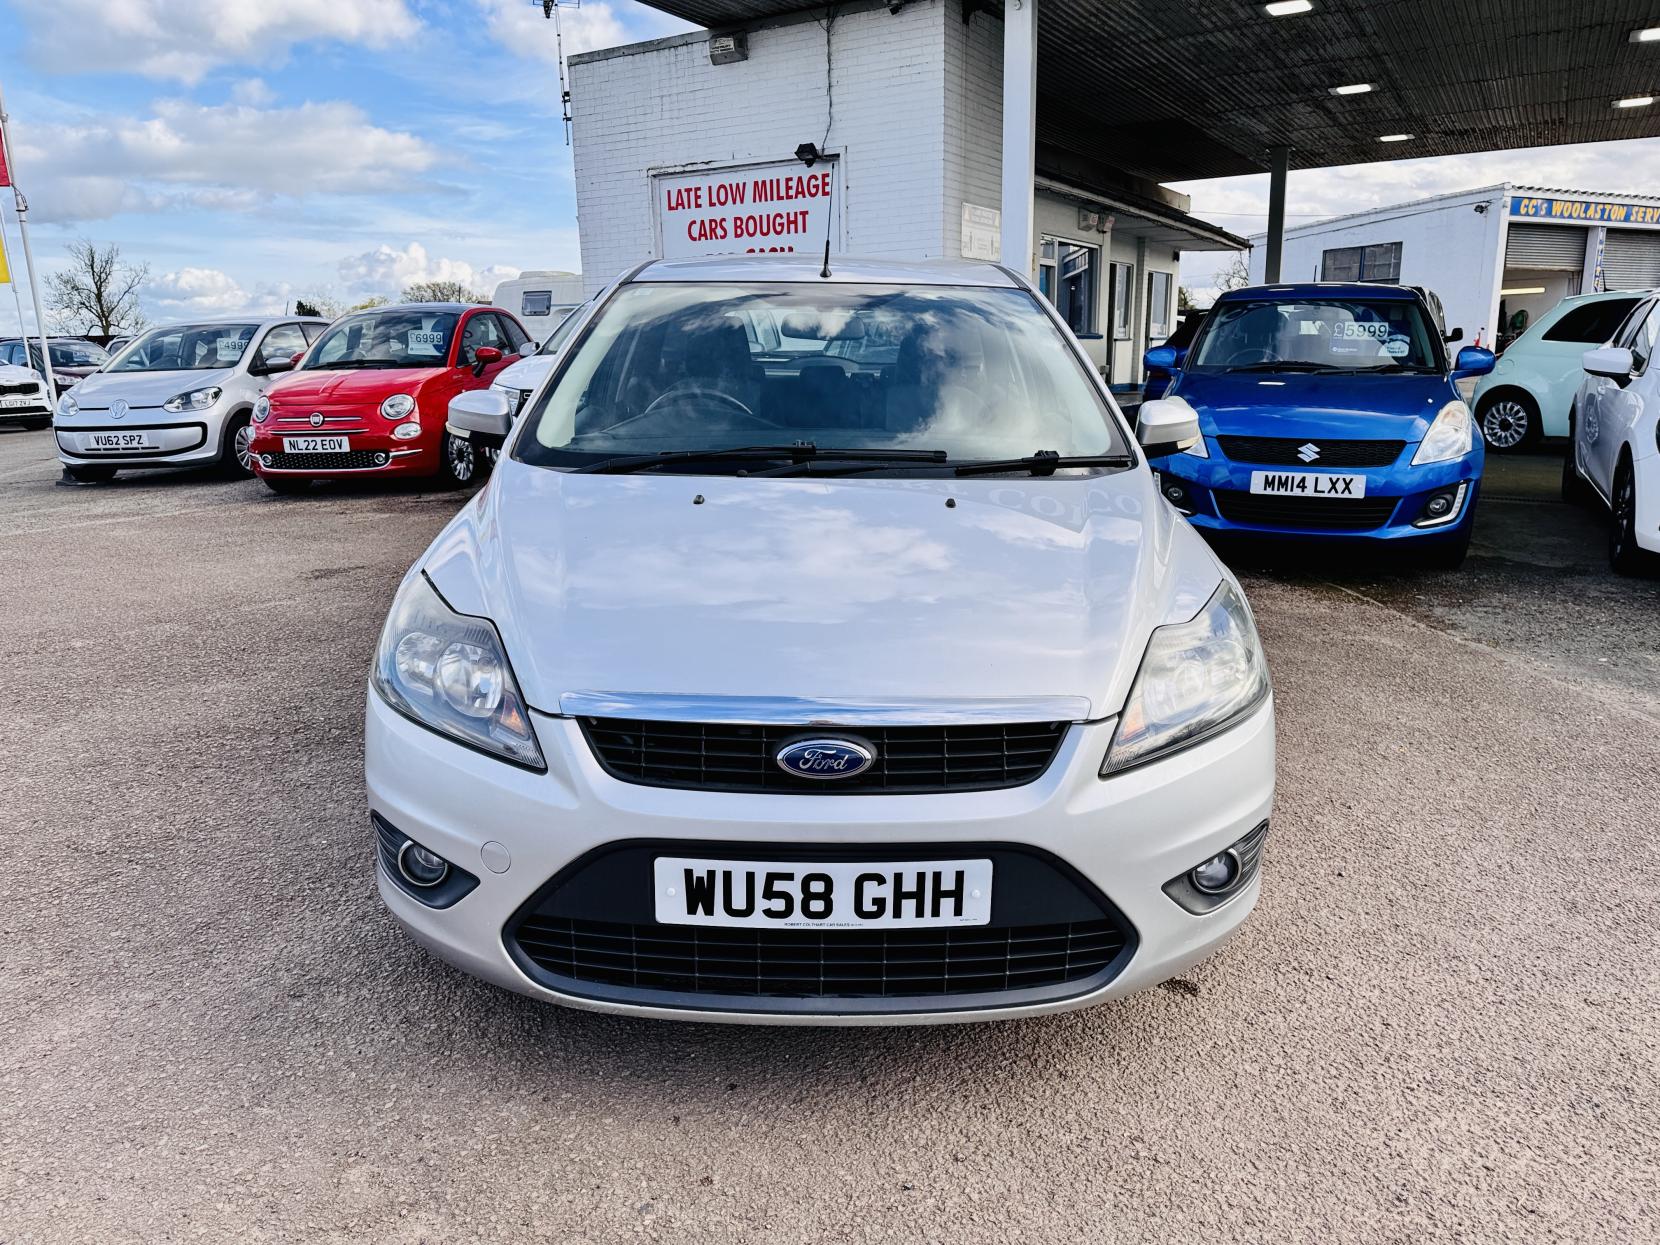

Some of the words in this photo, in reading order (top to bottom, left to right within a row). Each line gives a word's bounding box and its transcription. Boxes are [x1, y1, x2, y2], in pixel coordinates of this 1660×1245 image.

[667, 187, 702, 211] LATE
[708, 182, 746, 207] LOW
[753, 173, 830, 203] MILEAGE
[1551, 200, 1627, 221] WOOLASTON
[1630, 206, 1660, 223] SERV
[688, 217, 728, 241] CARS
[734, 211, 809, 238] BOUGHT
[94, 435, 120, 446] VU62
[122, 435, 144, 445] SPZ
[288, 439, 318, 451] NL22
[321, 439, 343, 450] EOV
[1263, 474, 1308, 493] MM14
[1313, 476, 1354, 495] LXX
[799, 748, 849, 770] Ford
[683, 868, 833, 920] WU58
[853, 870, 965, 920] GHH
